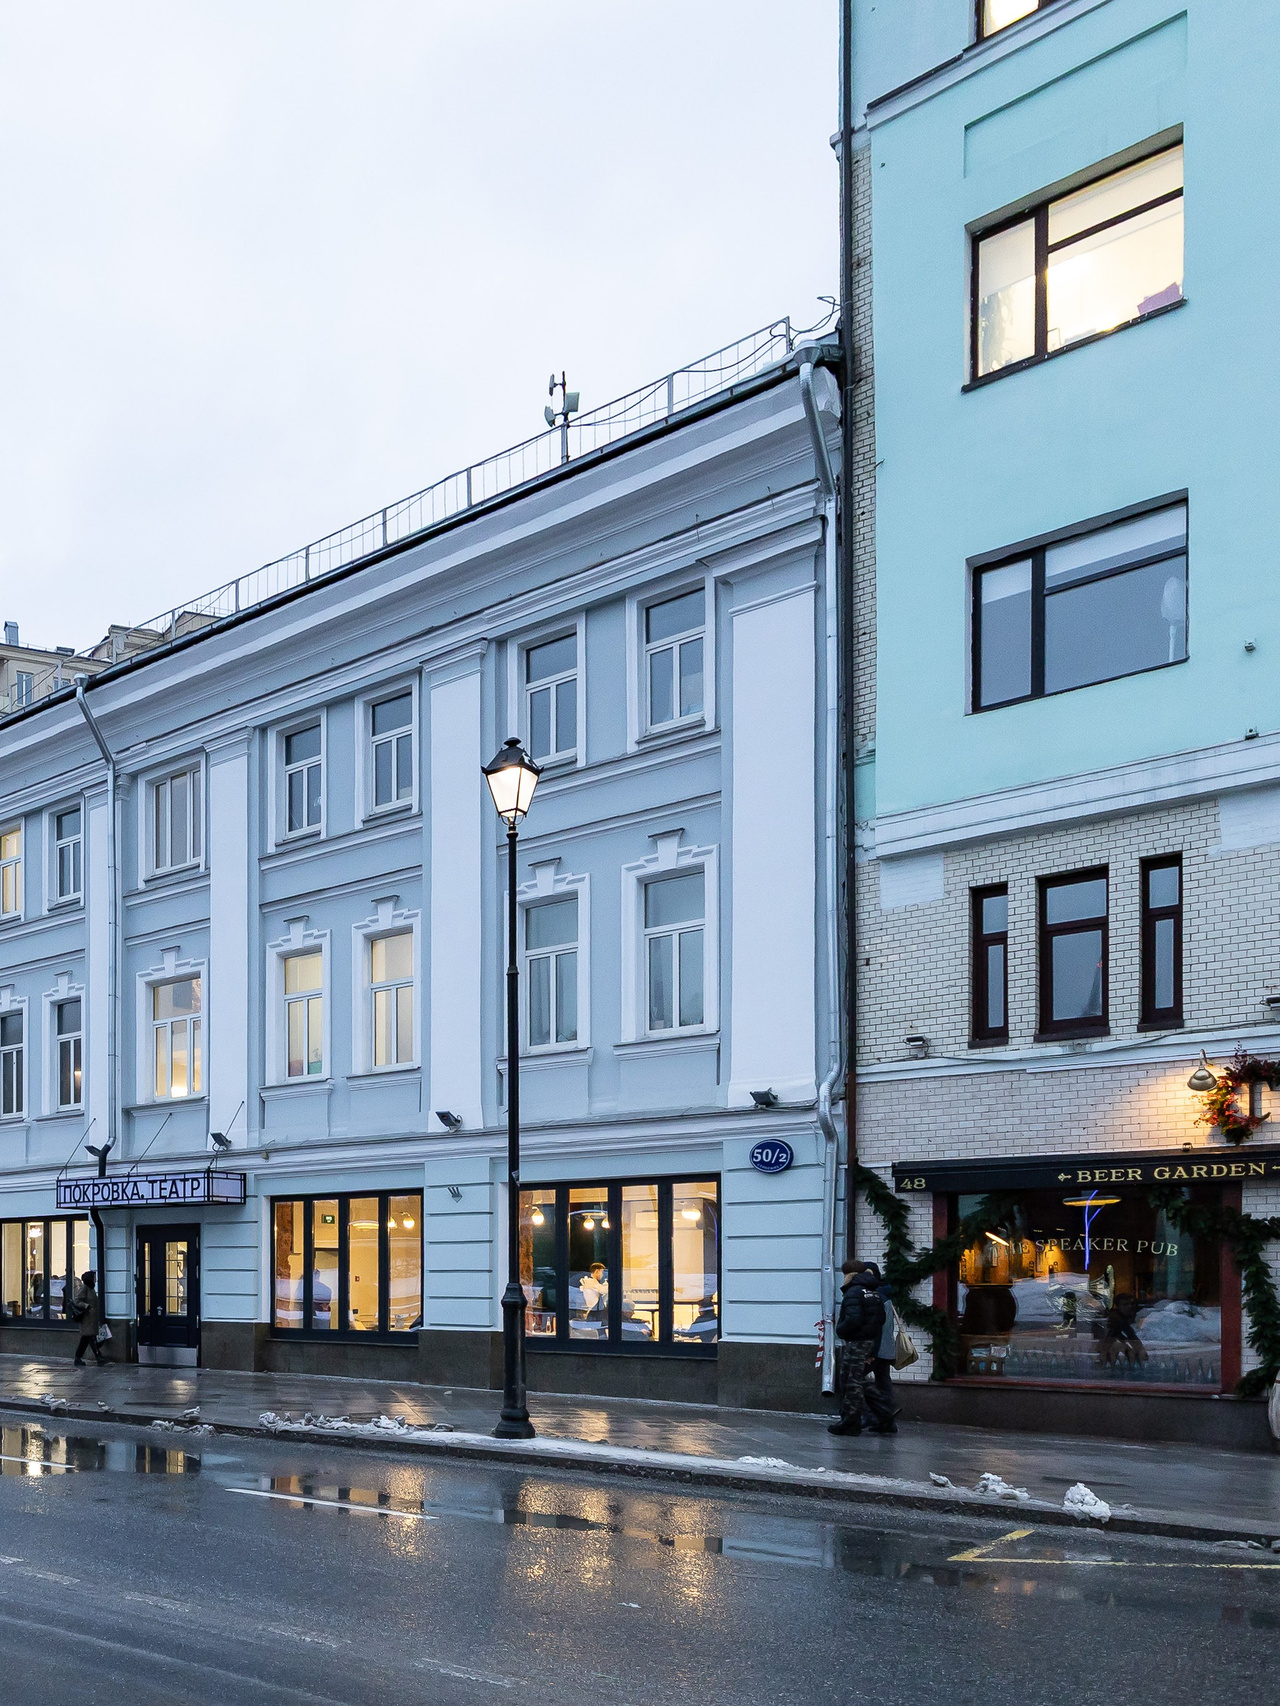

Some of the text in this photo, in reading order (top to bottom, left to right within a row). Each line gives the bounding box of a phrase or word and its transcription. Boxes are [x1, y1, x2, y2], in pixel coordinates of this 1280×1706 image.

[753, 1148, 787, 1164] 50/2
[1076, 1162, 1267, 1183] BEER GARDEN
[148, 1178, 201, 1199] ТЕАТР
[899, 1177, 926, 1190] 48
[1035, 1237, 1130, 1252] SPEAKER
[1136, 1240, 1179, 1257] PUB
